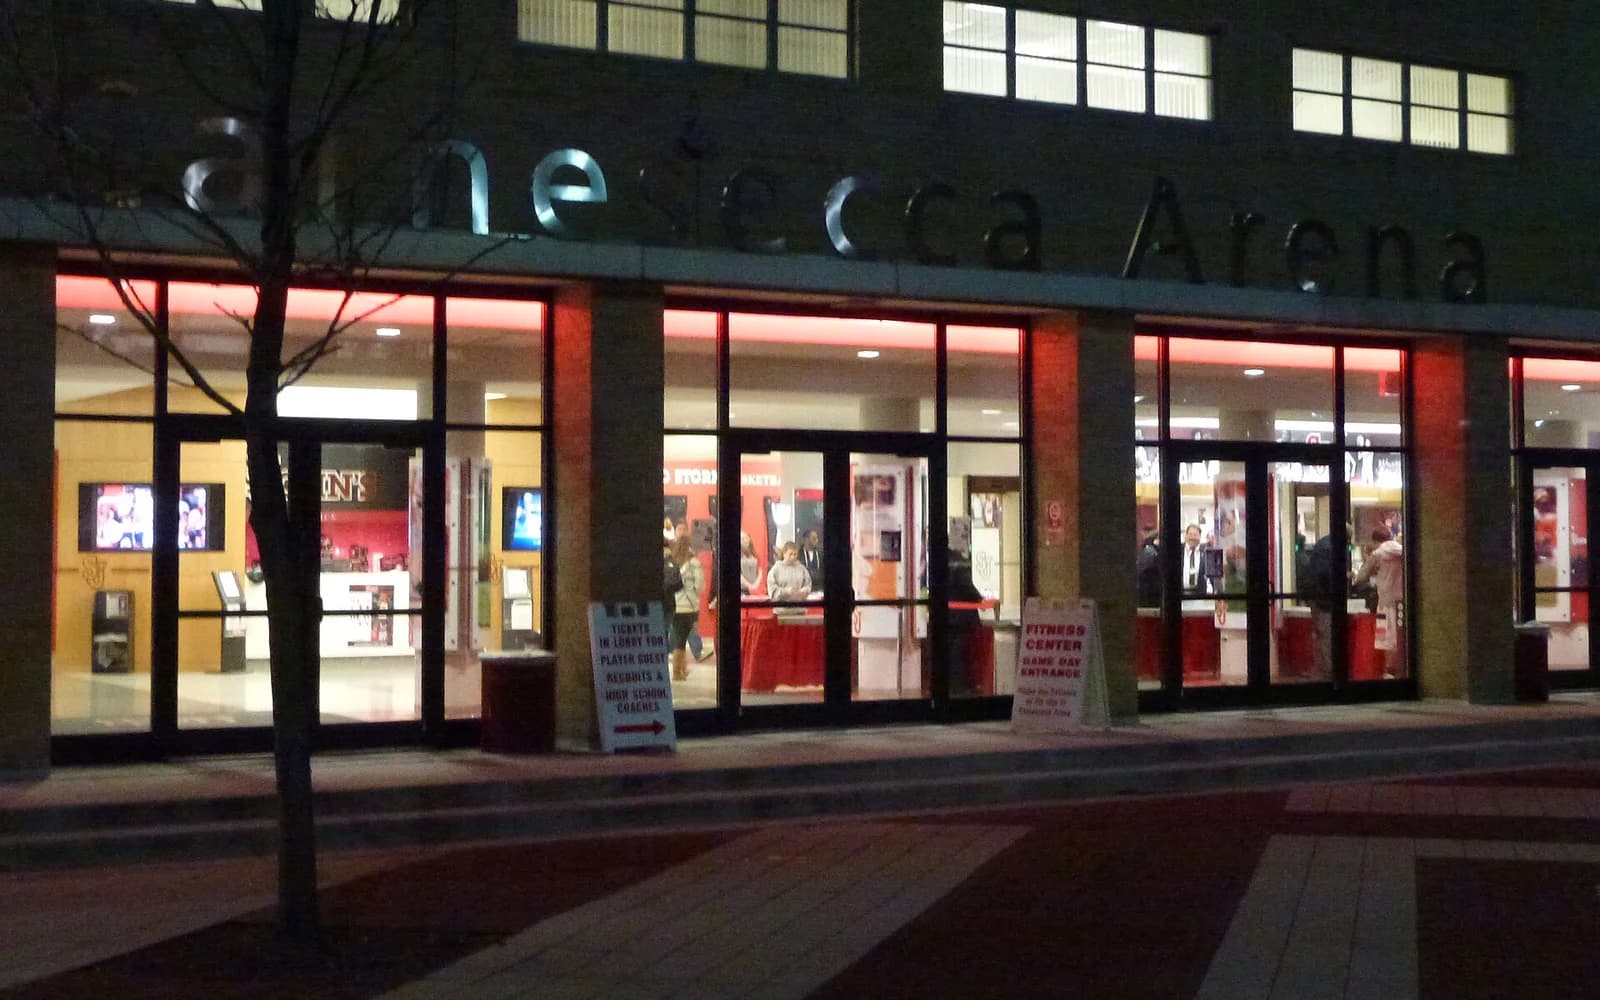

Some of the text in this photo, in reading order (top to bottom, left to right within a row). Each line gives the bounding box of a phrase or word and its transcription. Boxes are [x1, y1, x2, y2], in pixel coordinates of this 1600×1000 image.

[1122, 175, 1486, 304] Arena
[1026, 624, 1088, 636] FITNESS
[599, 635, 665, 649] IN LOBBY FOR
[1025, 639, 1082, 651] CENTER
[600, 653, 635, 665] PLAYER
[1022, 657, 1082, 667] GAME DAY
[1020, 668, 1082, 679] ENTRANCE
[605, 688, 668, 701] HIGH SCHOOL
[616, 702, 660, 714] COACHES
